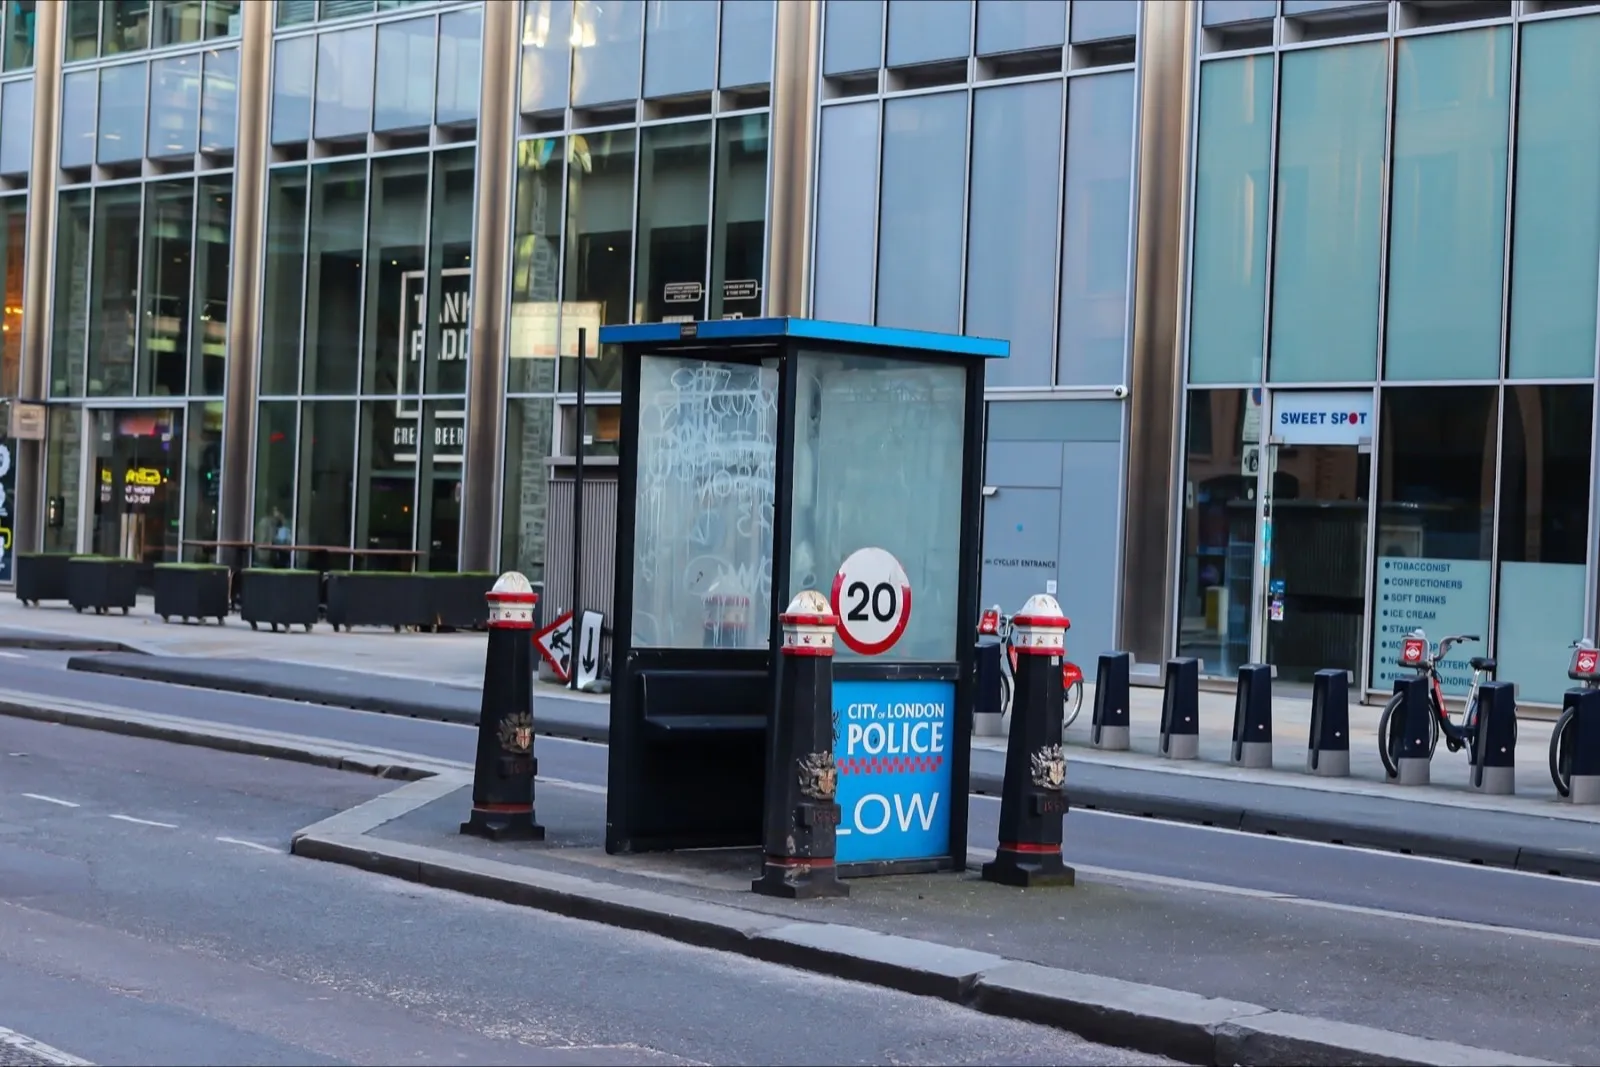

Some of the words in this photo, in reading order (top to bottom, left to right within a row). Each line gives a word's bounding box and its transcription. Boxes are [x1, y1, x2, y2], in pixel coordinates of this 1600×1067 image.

[414, 291, 471, 325] TNK
[1281, 412, 1327, 425] SWEET
[1331, 412, 1367, 425] SPOT
[435, 427, 464, 445] BEER
[1021, 560, 1056, 568] ENTRANCE
[1393, 562, 1451, 572] TOBACCONIST
[1391, 578, 1463, 589] CONFECTIONERS
[847, 581, 897, 622] 20
[1390, 593, 1412, 603] SOFT
[1415, 595, 1447, 605] DRINKS
[1390, 610, 1402, 618] ICE
[1406, 610, 1436, 620] CREAM
[1389, 625, 1422, 634] STAMP
[1436, 659, 1469, 670] OTTERY
[848, 703, 878, 719] CITY
[887, 703, 945, 718] LONDON
[847, 722, 944, 755] POLICE
